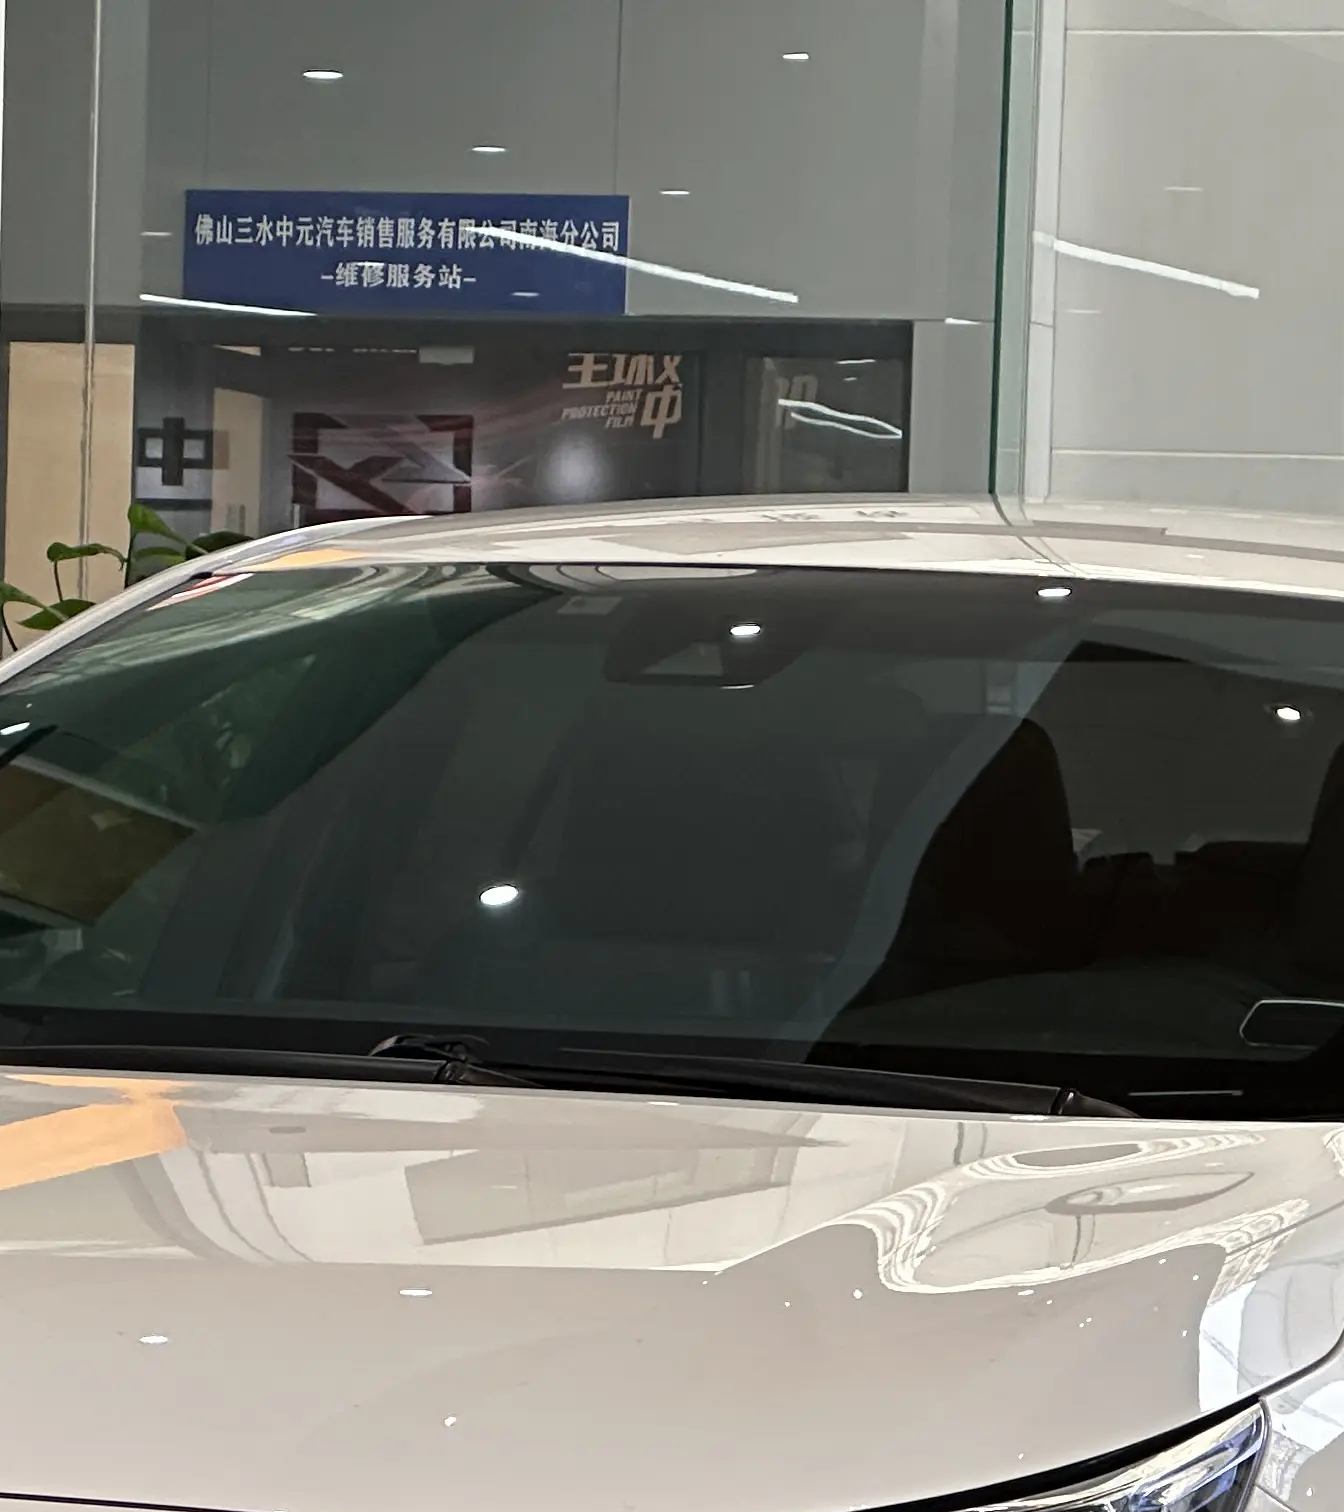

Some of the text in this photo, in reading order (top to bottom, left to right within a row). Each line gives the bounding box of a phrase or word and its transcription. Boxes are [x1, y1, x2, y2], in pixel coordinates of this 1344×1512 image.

[194, 213, 621, 253] 佛山三水中元汽车销售服务有限公司南海分公司
[606, 389, 644, 403] PAINT
[605, 415, 635, 429] FILM
